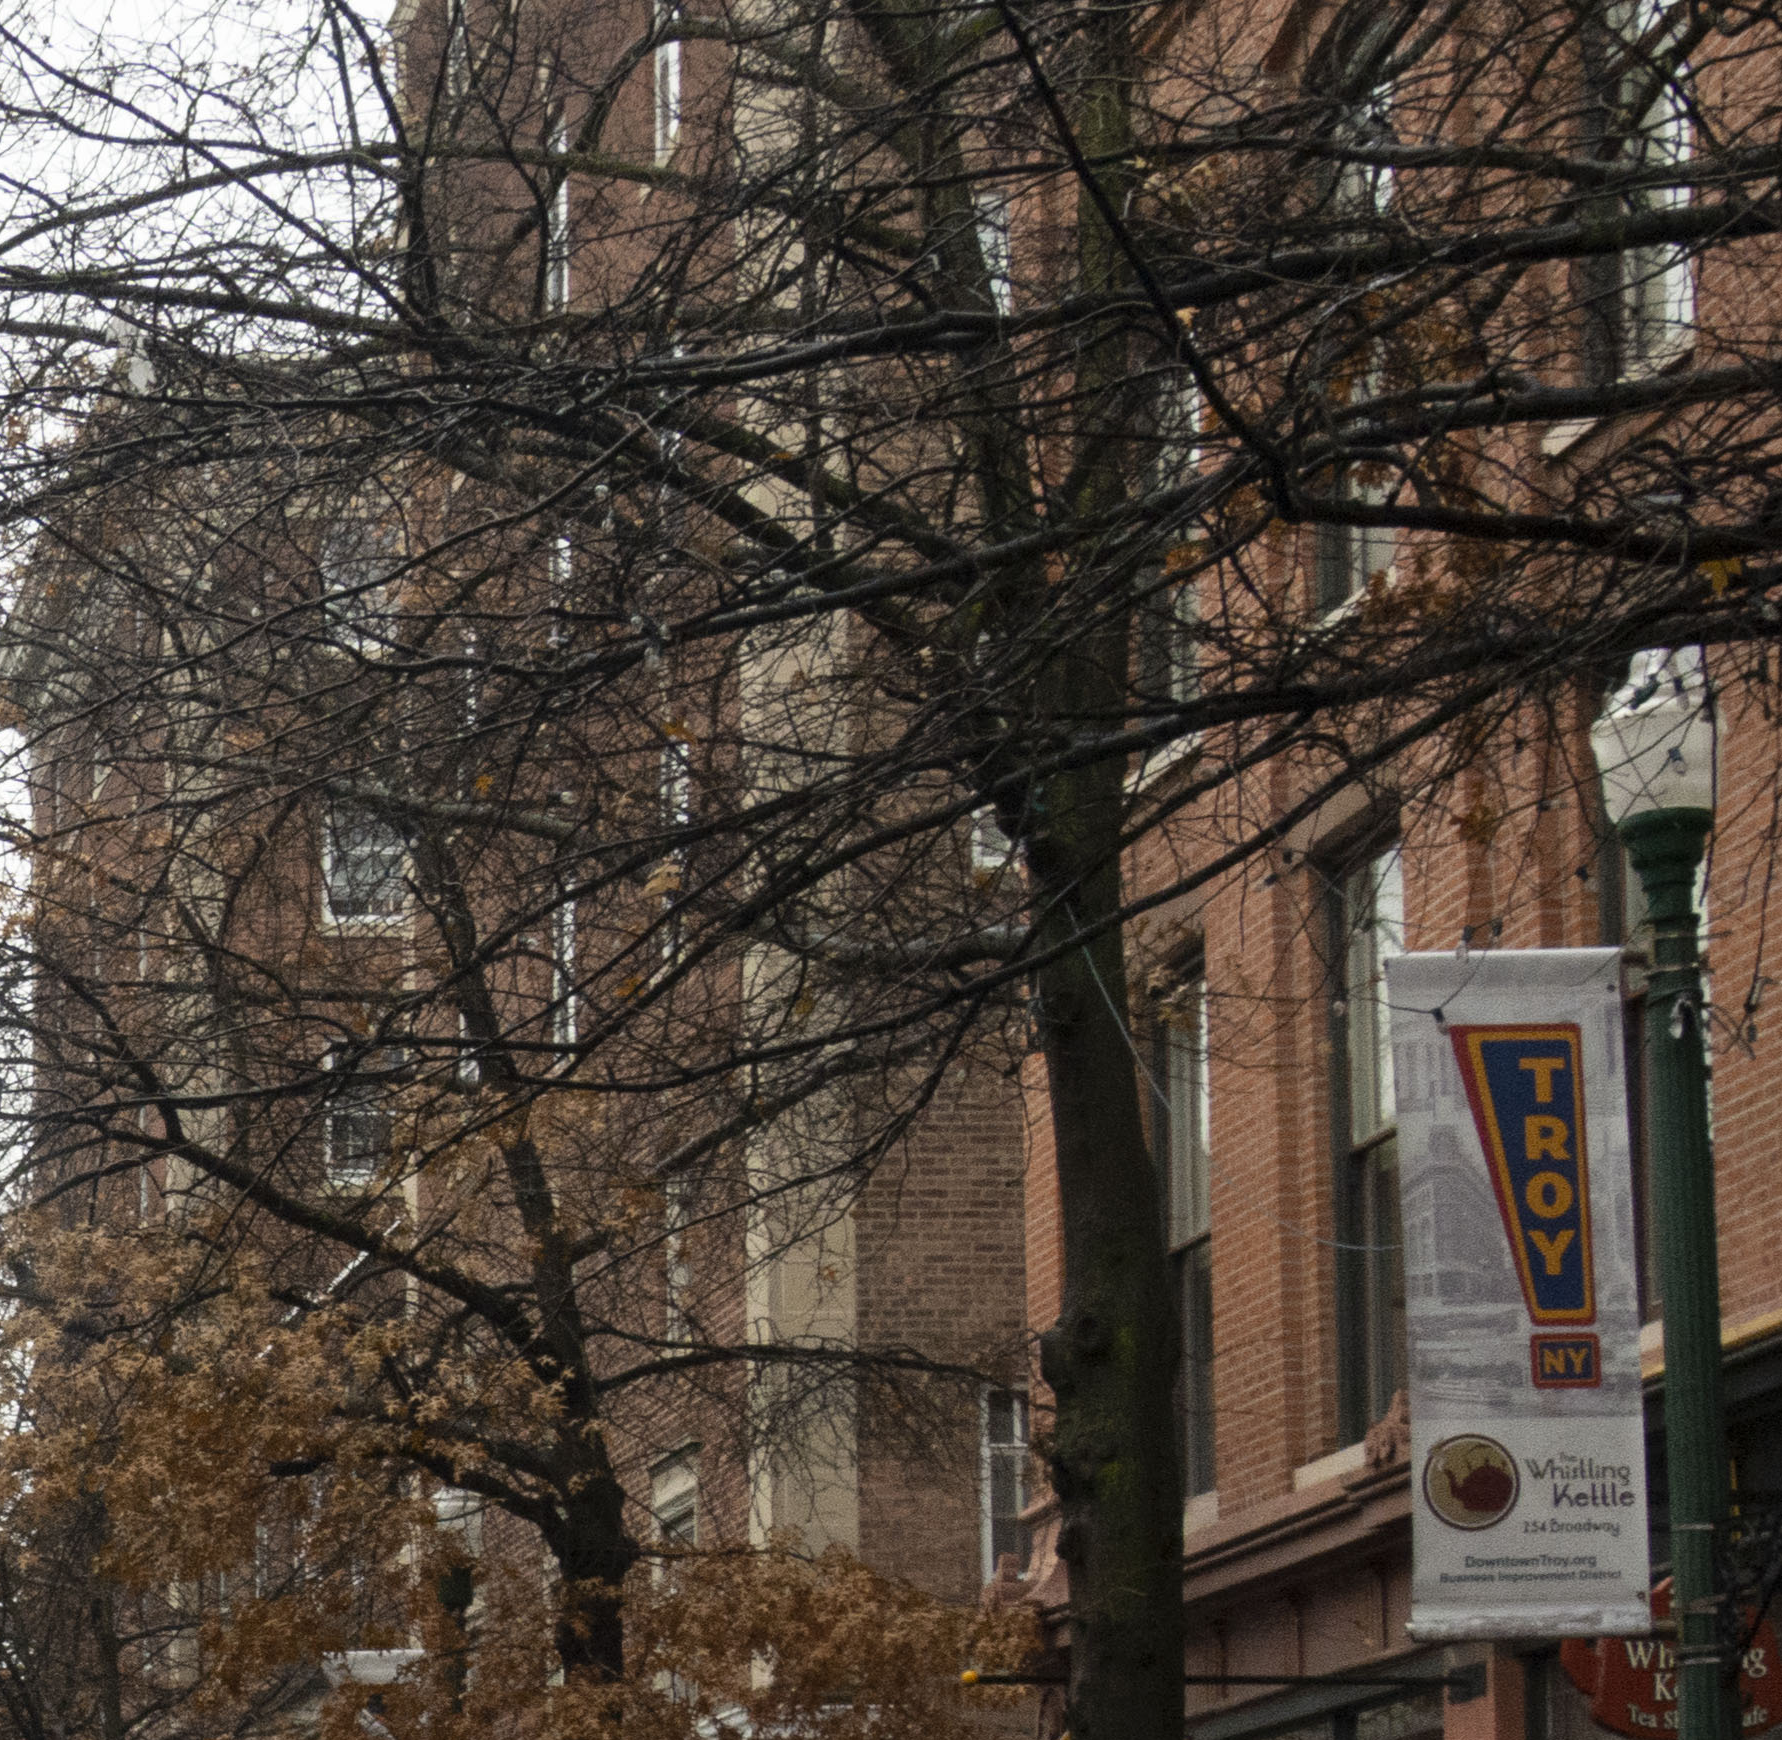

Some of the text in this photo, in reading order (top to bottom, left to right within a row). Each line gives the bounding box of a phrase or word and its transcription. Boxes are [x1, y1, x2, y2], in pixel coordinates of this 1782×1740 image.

[1518, 1057, 1576, 1275] TROY
[1542, 1347, 1588, 1374] NY
[1523, 1458, 1632, 1486] Whistling
[1553, 1482, 1635, 1508] Kettle
[1549, 1518, 1621, 1537] Broadway
[1464, 1554, 1598, 1569] DowntownTroy.org
[1742, 1705, 1769, 1728] afe
